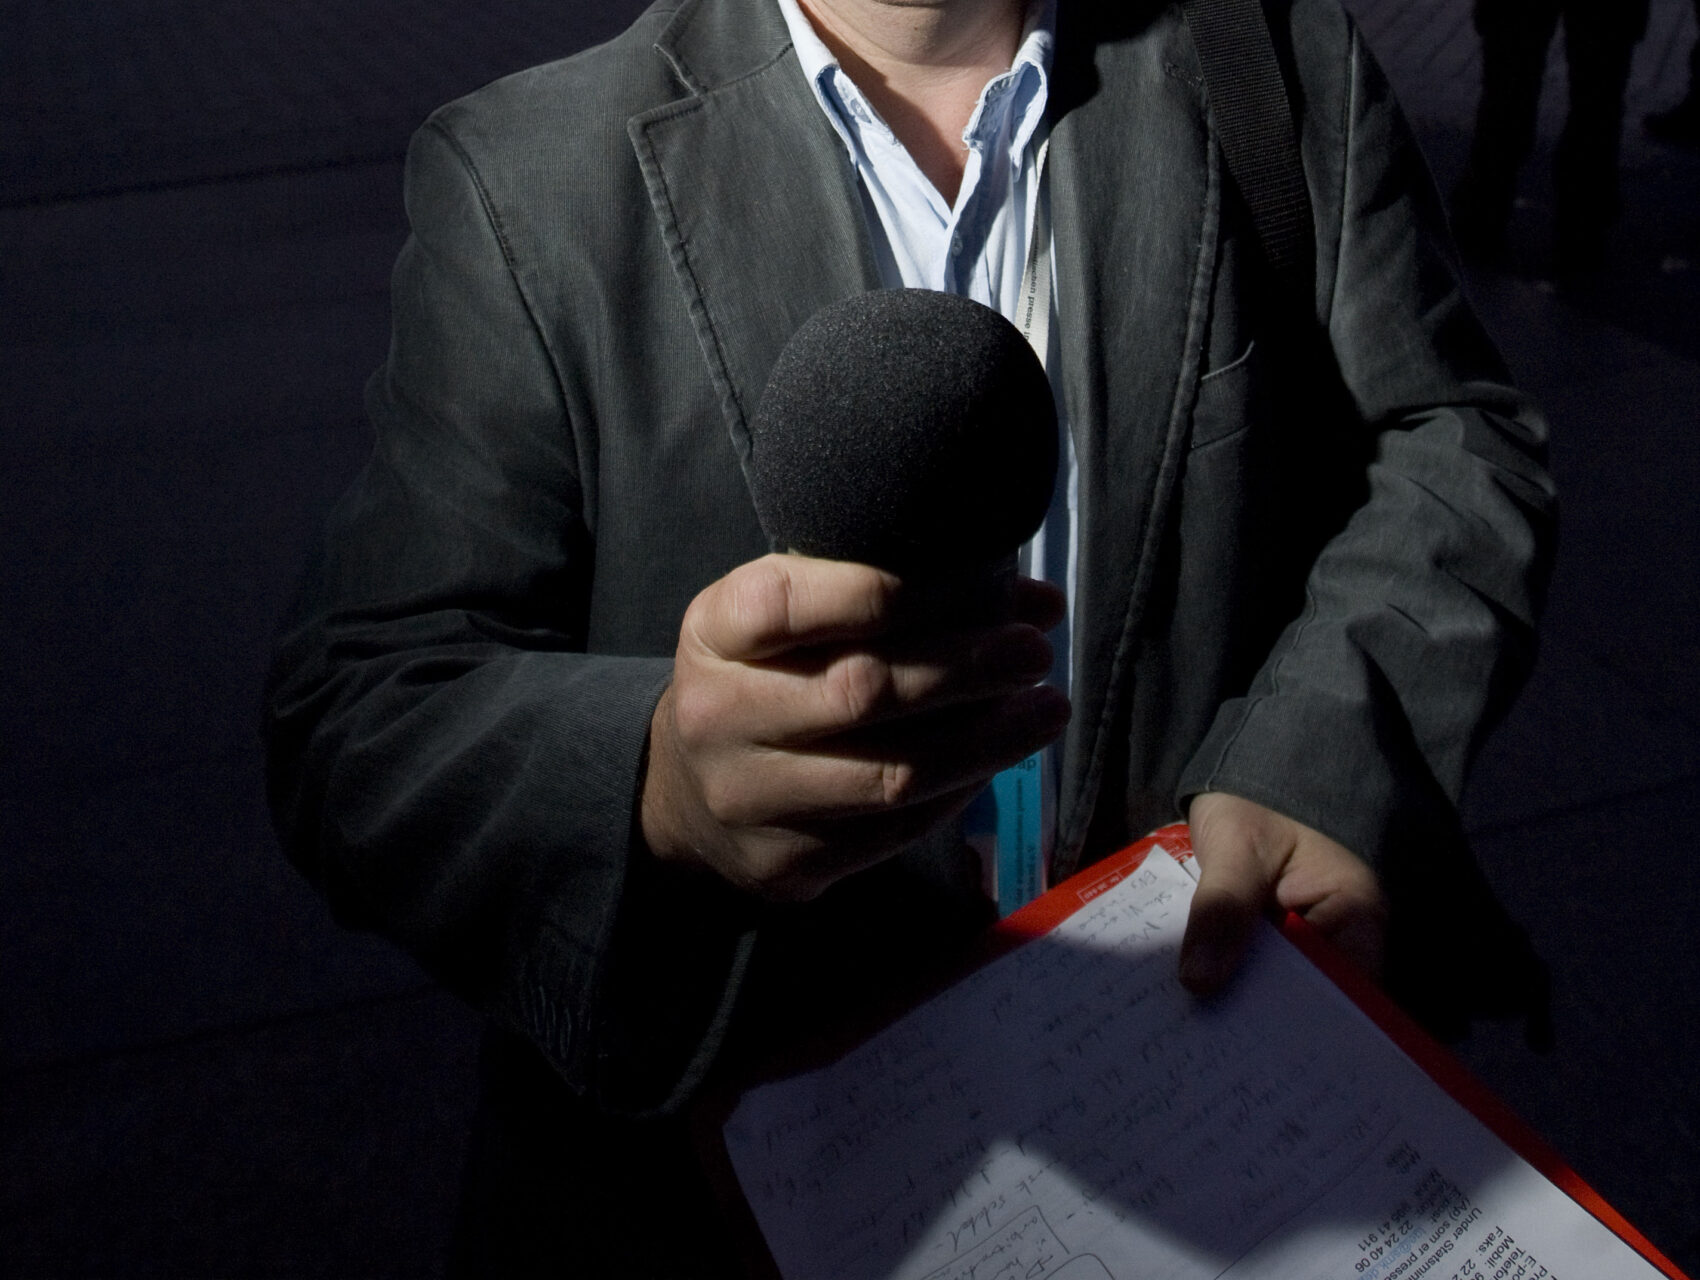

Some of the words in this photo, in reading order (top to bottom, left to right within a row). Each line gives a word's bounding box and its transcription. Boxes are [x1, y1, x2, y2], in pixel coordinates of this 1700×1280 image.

[1024, 296, 1034, 328] presse
[1448, 1196, 1471, 1221] (Ap)
[1377, 1220, 1392, 1234] 41
[1397, 1219, 1413, 1236] 22
[1428, 1220, 1450, 1243] som
[1450, 1206, 1482, 1240] Under
[1357, 1232, 1378, 1252] 911
[1383, 1232, 1400, 1248] 24
[1416, 1241, 1429, 1256] er
[1475, 1225, 1503, 1256] Faks:
[1368, 1244, 1385, 1260] 40
[1483, 1235, 1514, 1269] Mobil:
[1353, 1256, 1371, 1272] 06
[1458, 1258, 1476, 1276] 22
